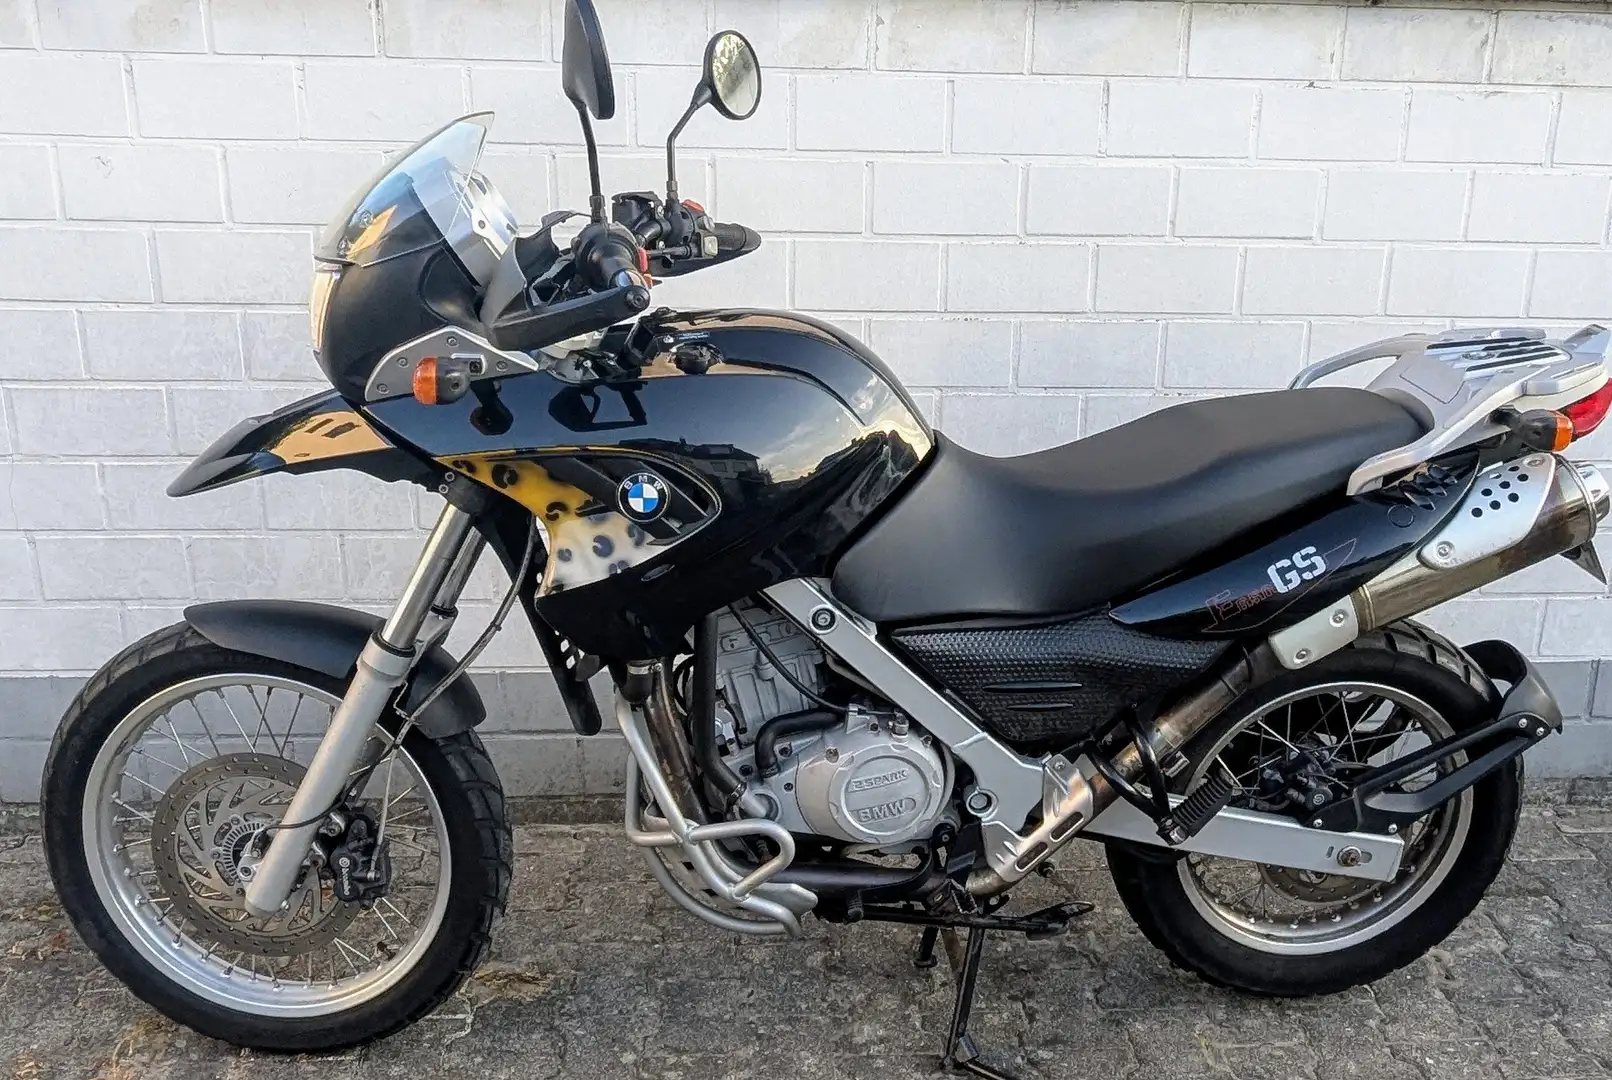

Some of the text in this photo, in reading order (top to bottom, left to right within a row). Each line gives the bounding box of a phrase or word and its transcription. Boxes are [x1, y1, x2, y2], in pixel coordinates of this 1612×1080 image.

[623, 475, 663, 490] BMW
[1267, 545, 1327, 594] GS
[859, 798, 906, 822] BMW
